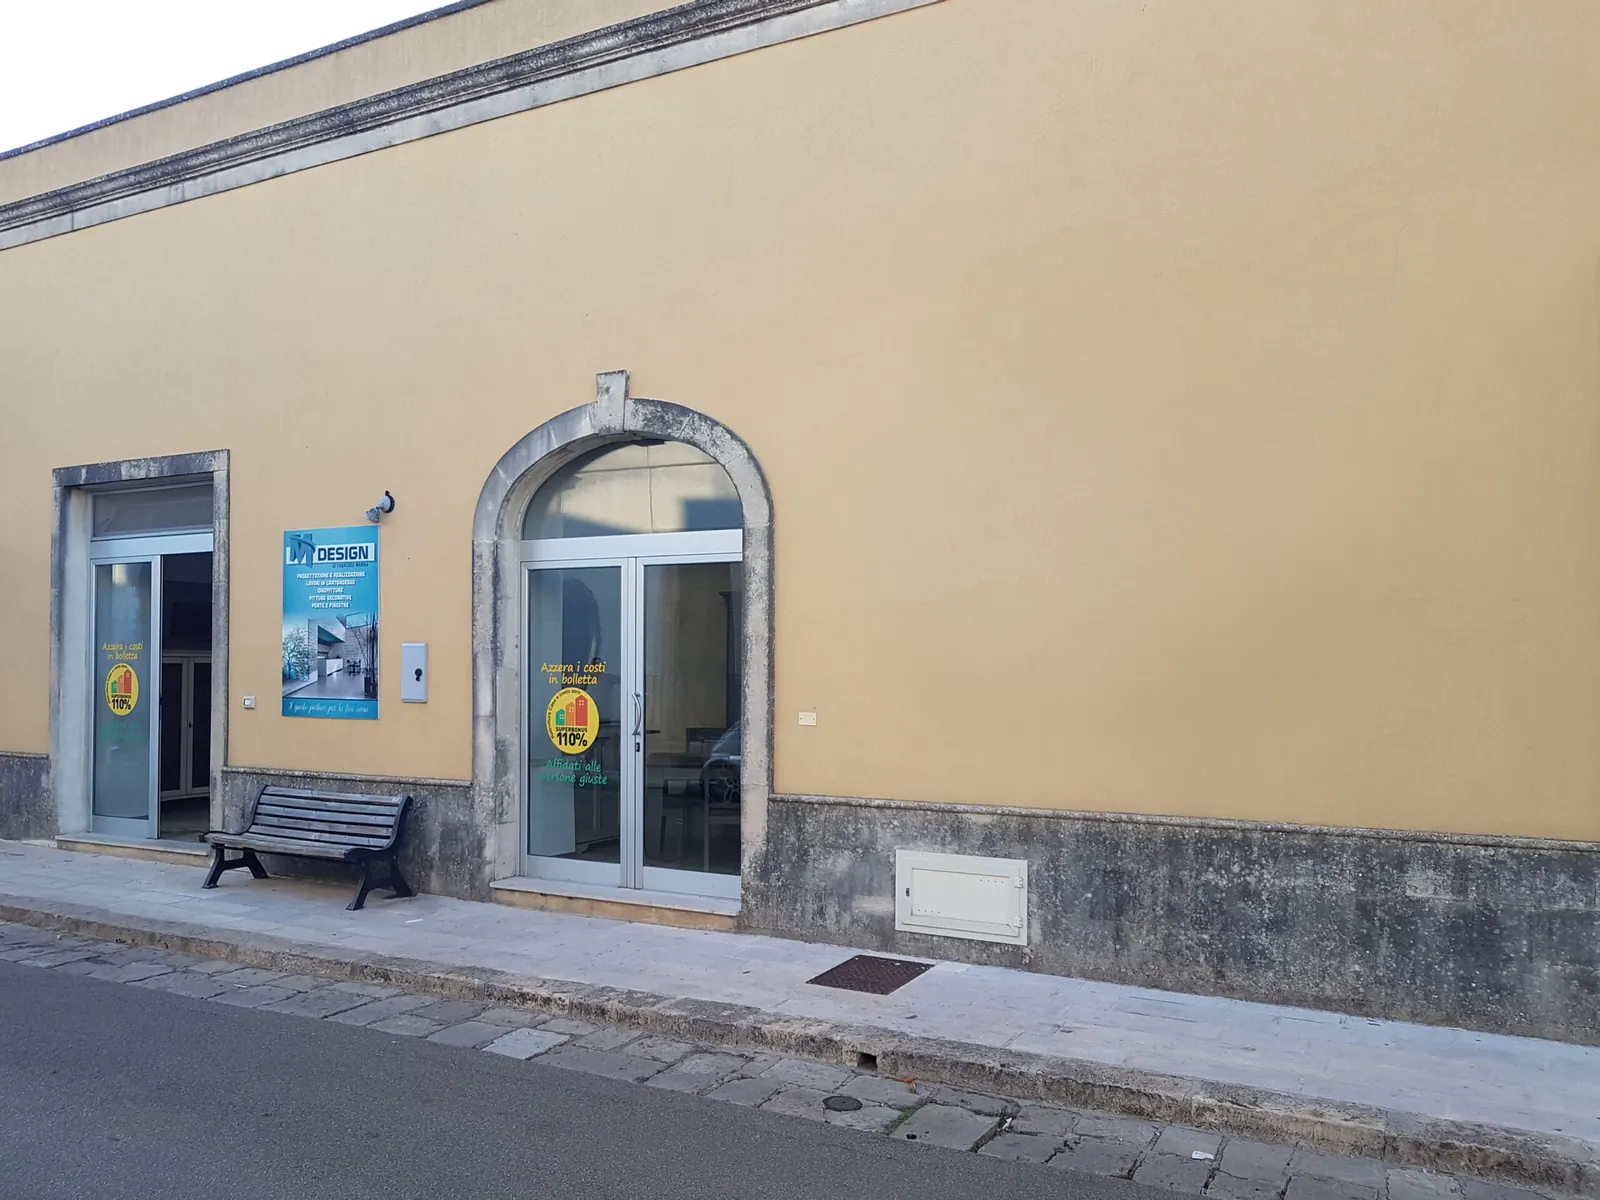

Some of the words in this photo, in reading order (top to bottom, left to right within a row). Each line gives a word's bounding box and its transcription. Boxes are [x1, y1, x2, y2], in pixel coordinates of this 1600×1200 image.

[318, 546, 369, 561] DESIGN
[541, 662, 574, 673] Azzera
[577, 661, 581, 673] i
[583, 661, 607, 673] costi
[548, 673, 559, 684] in
[561, 673, 598, 685] bolletta
[112, 698, 132, 710] 110%
[557, 732, 588, 747] 110%
[546, 758, 582, 771] Affidati
[584, 760, 602, 773] alle
[578, 772, 608, 787] giuste
